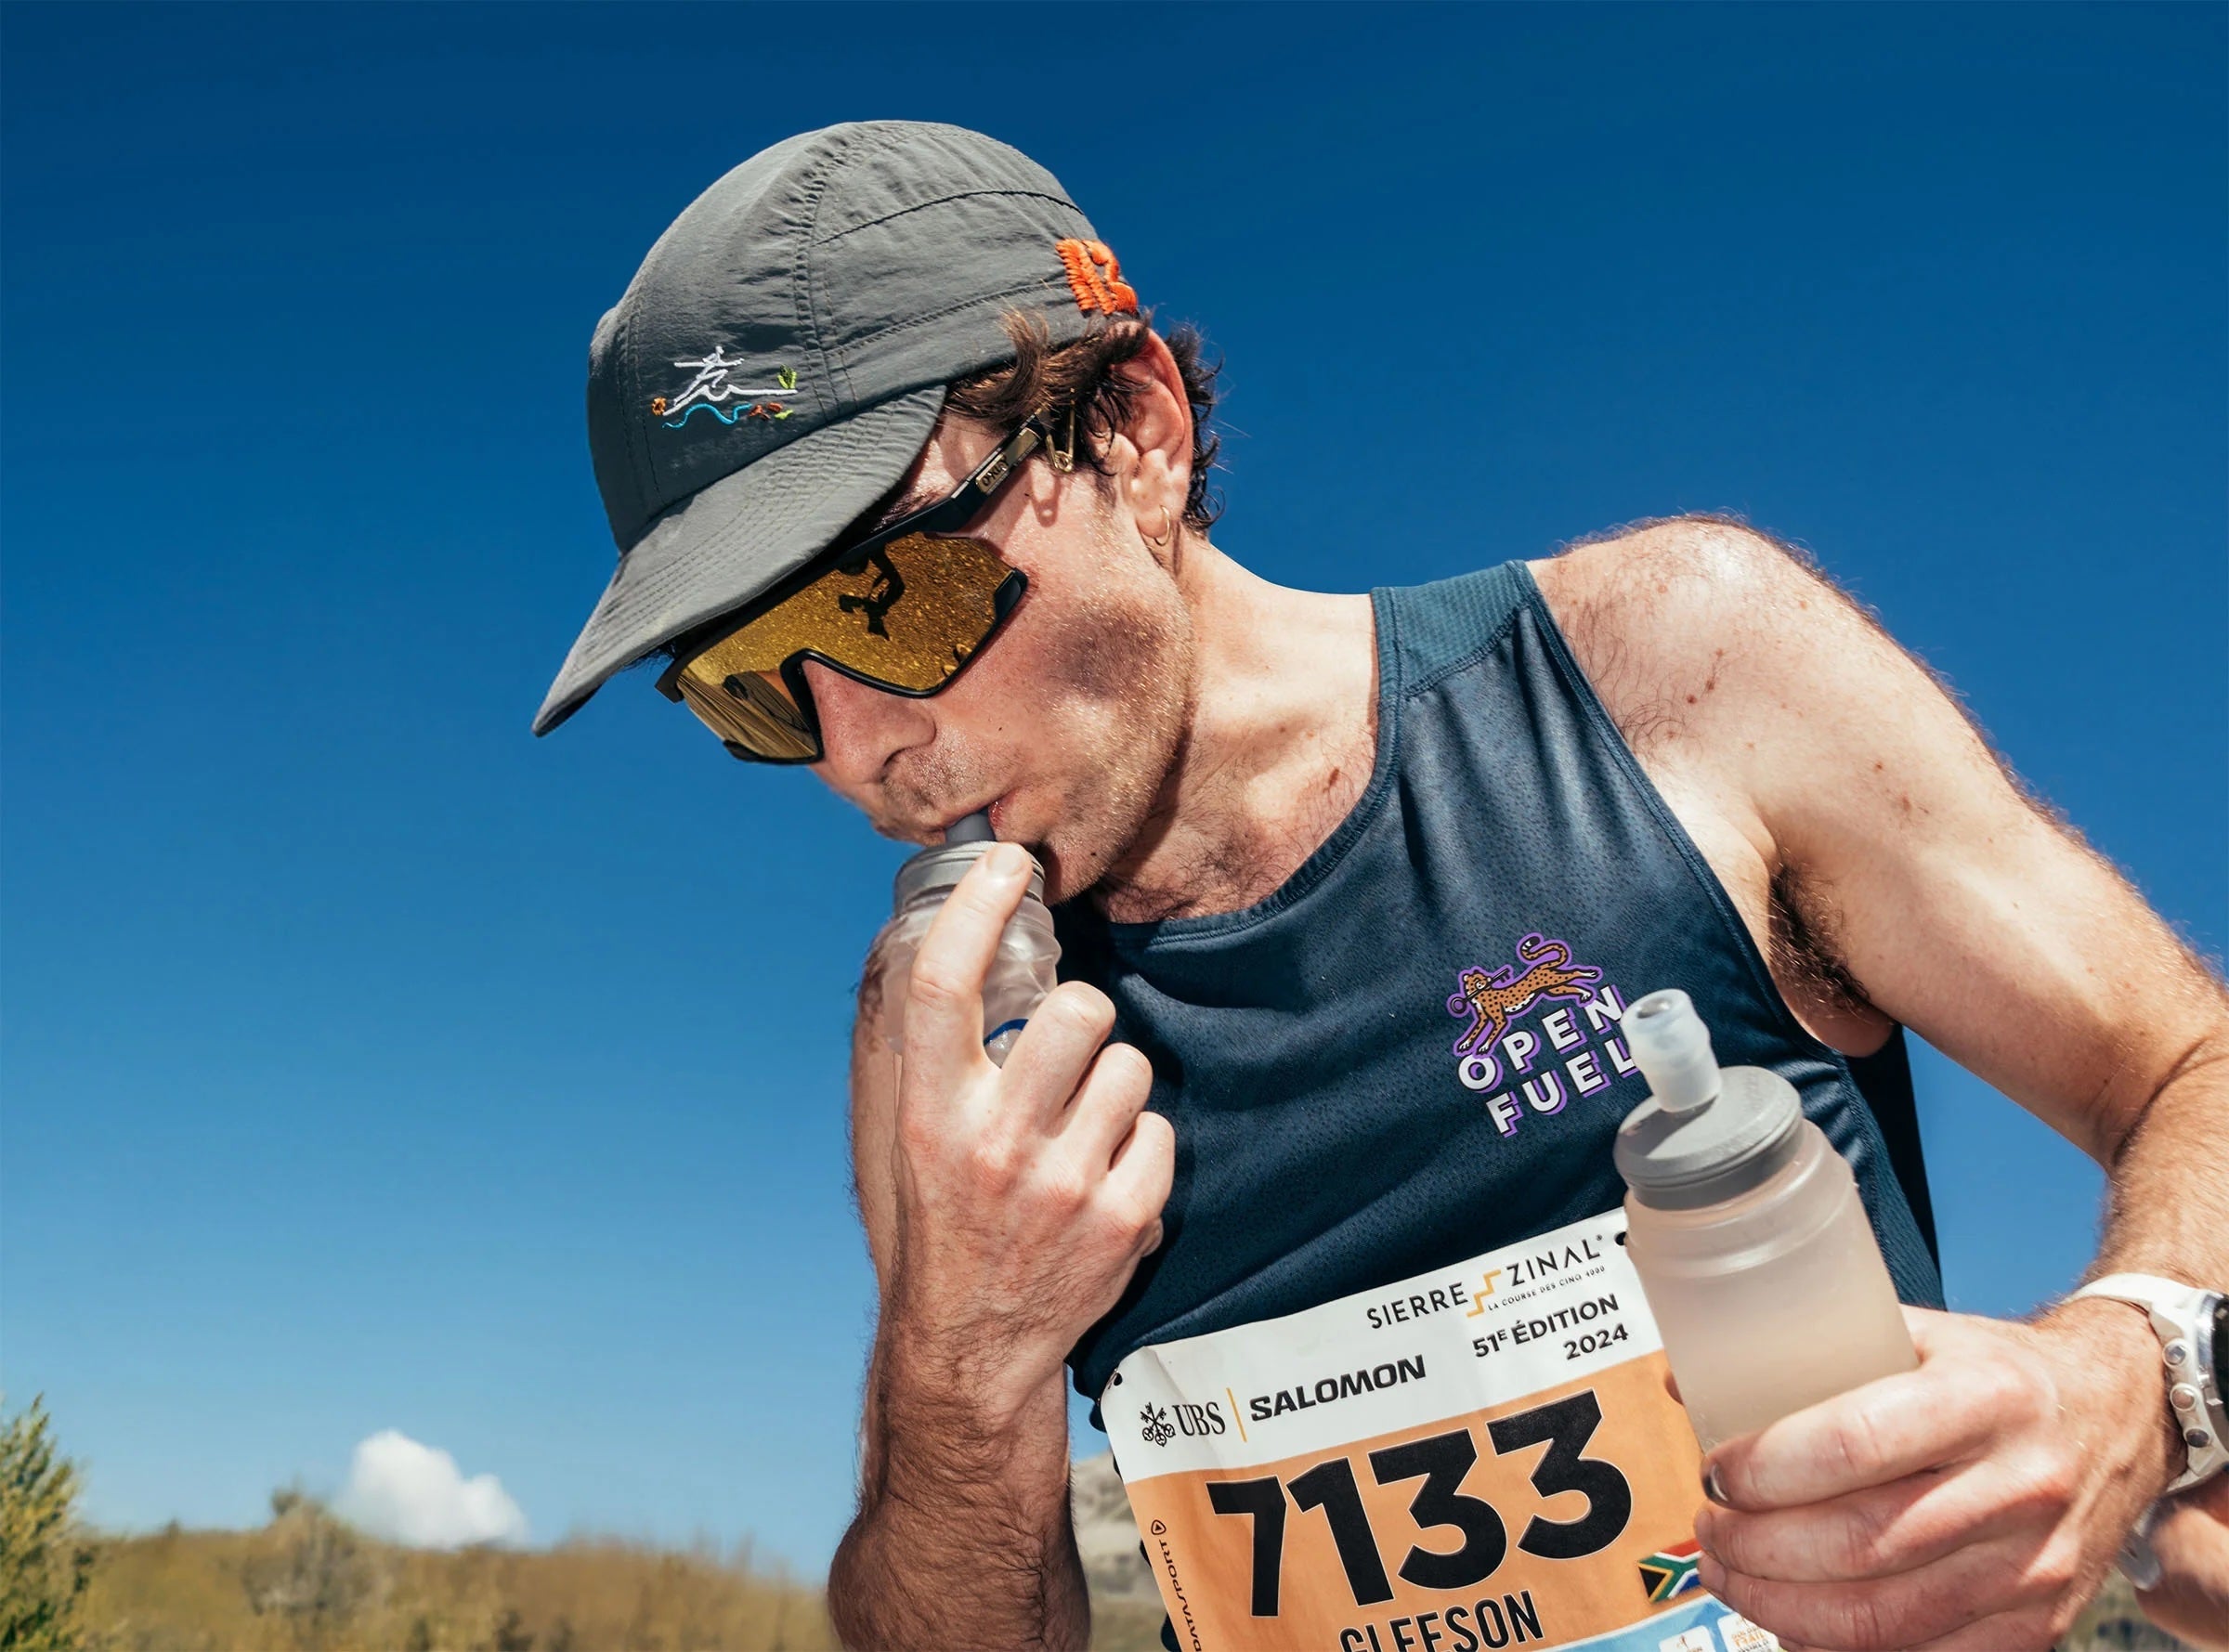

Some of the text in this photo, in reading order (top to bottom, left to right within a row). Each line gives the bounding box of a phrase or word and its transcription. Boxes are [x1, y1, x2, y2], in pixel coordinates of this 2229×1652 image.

[1458, 984, 1625, 1094] OPEN
[1486, 1037, 1640, 1138] FUEL
[1367, 1281, 1468, 1329] SIERRE
[1502, 1291, 1537, 1307] COURSE
[1510, 1293, 1620, 1346] ÉDITION
[1563, 1322, 1630, 1360] 2024
[1172, 1354, 1427, 1437] UBS SALOMON
[1206, 1388, 1633, 1618] 7133
